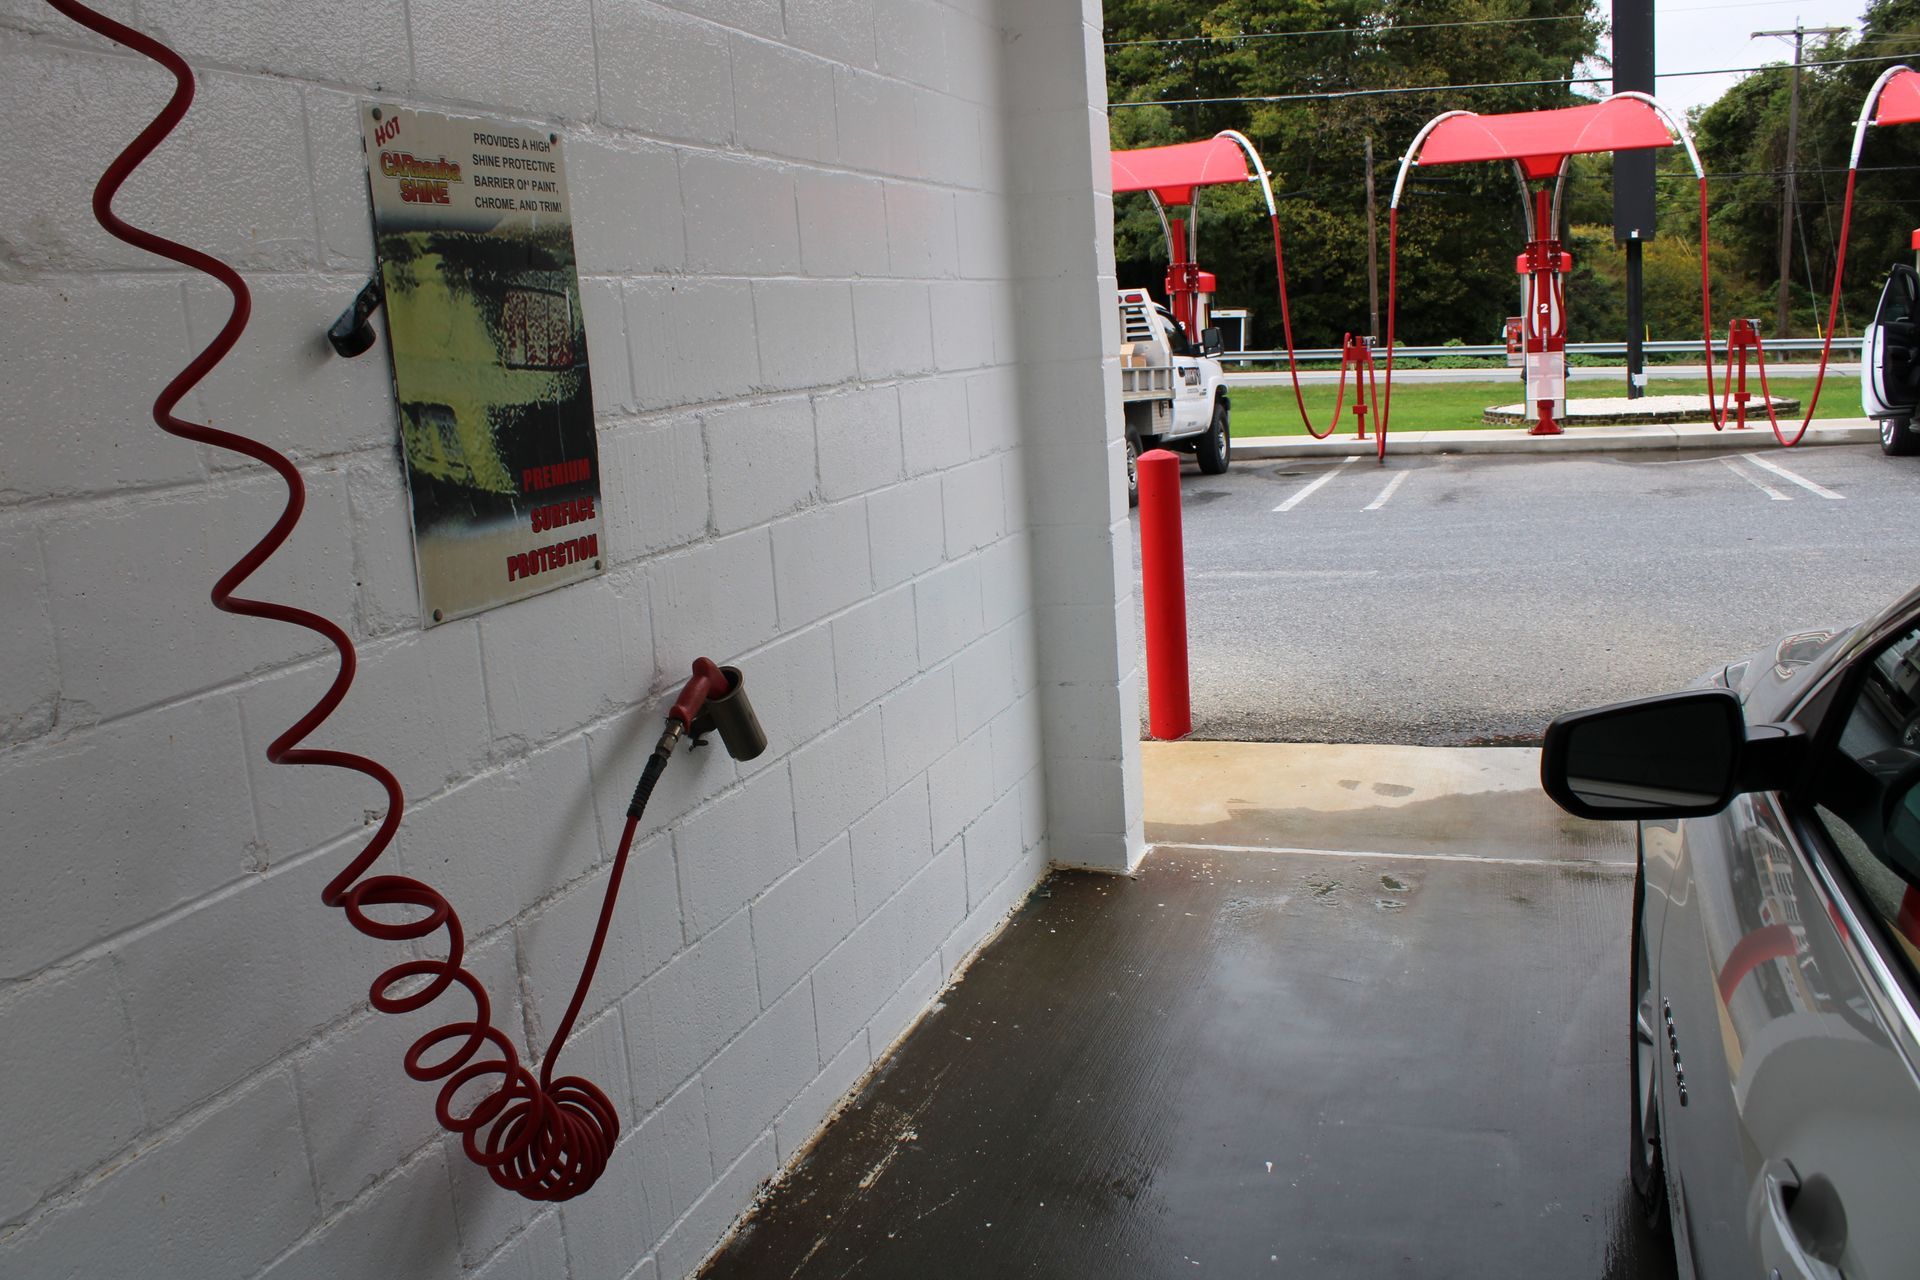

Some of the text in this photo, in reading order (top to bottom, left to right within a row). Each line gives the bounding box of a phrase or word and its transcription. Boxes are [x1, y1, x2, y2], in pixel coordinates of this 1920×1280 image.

[374, 116, 400, 147] HOT
[473, 132, 551, 153] PROVIDES A HIGH
[472, 153, 556, 174] SHINE PROTECTIVE
[400, 178, 450, 204] SHINE
[473, 175, 560, 196] BARRIER ON PAINT,
[474, 196, 563, 213] CHROME, AND TRIM!
[1540, 303, 1549, 313] 2
[522, 458, 590, 492] PREMIUM
[531, 495, 595, 533] SURFACE
[506, 533, 599, 582] PROTECTION
